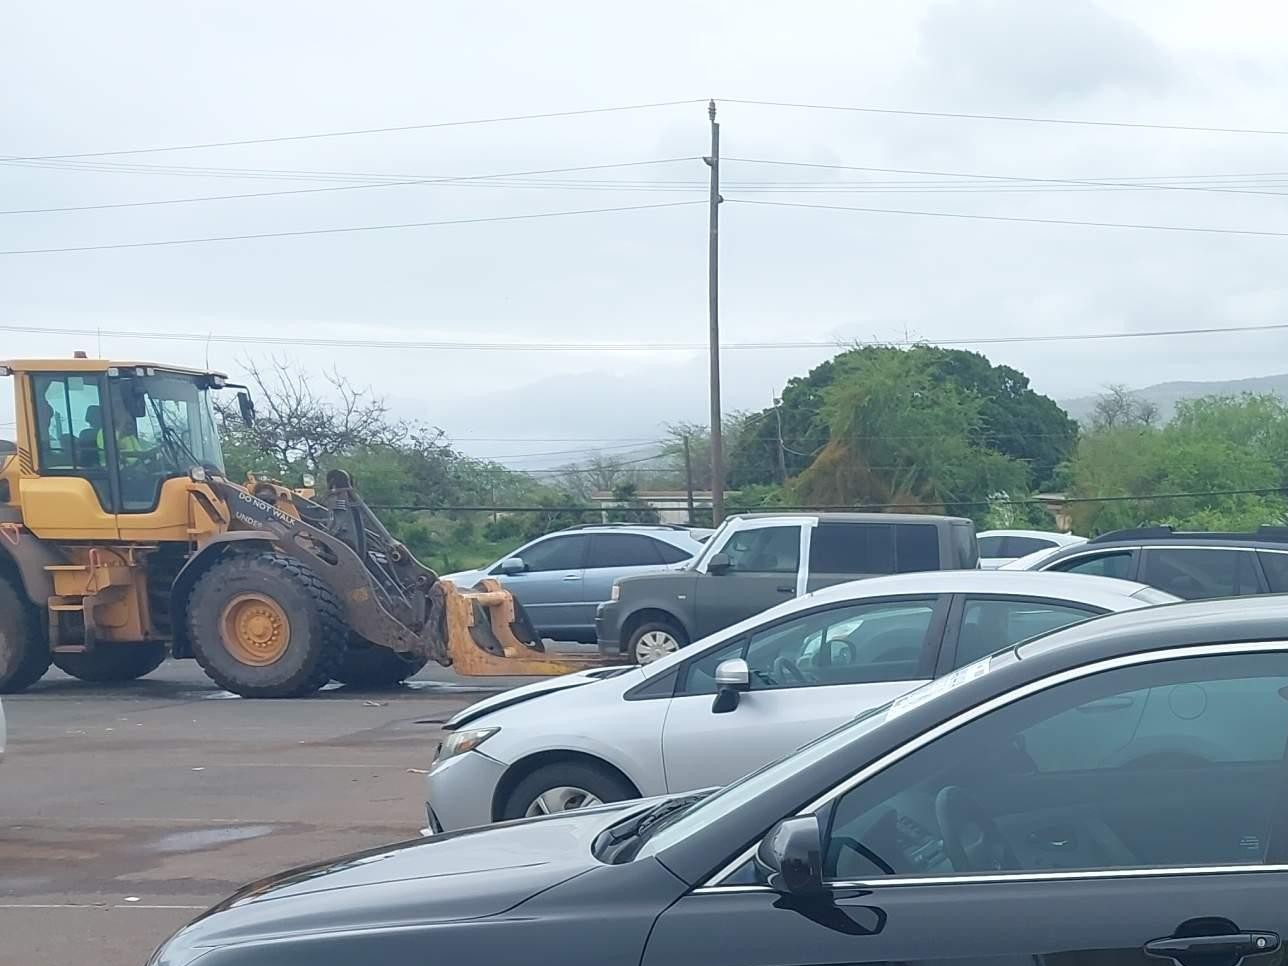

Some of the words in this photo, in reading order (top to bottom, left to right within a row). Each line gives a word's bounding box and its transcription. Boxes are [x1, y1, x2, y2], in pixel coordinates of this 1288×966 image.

[239, 492, 252, 502] DO
[253, 500, 272, 512] NOT
[273, 509, 295, 526] WALK
